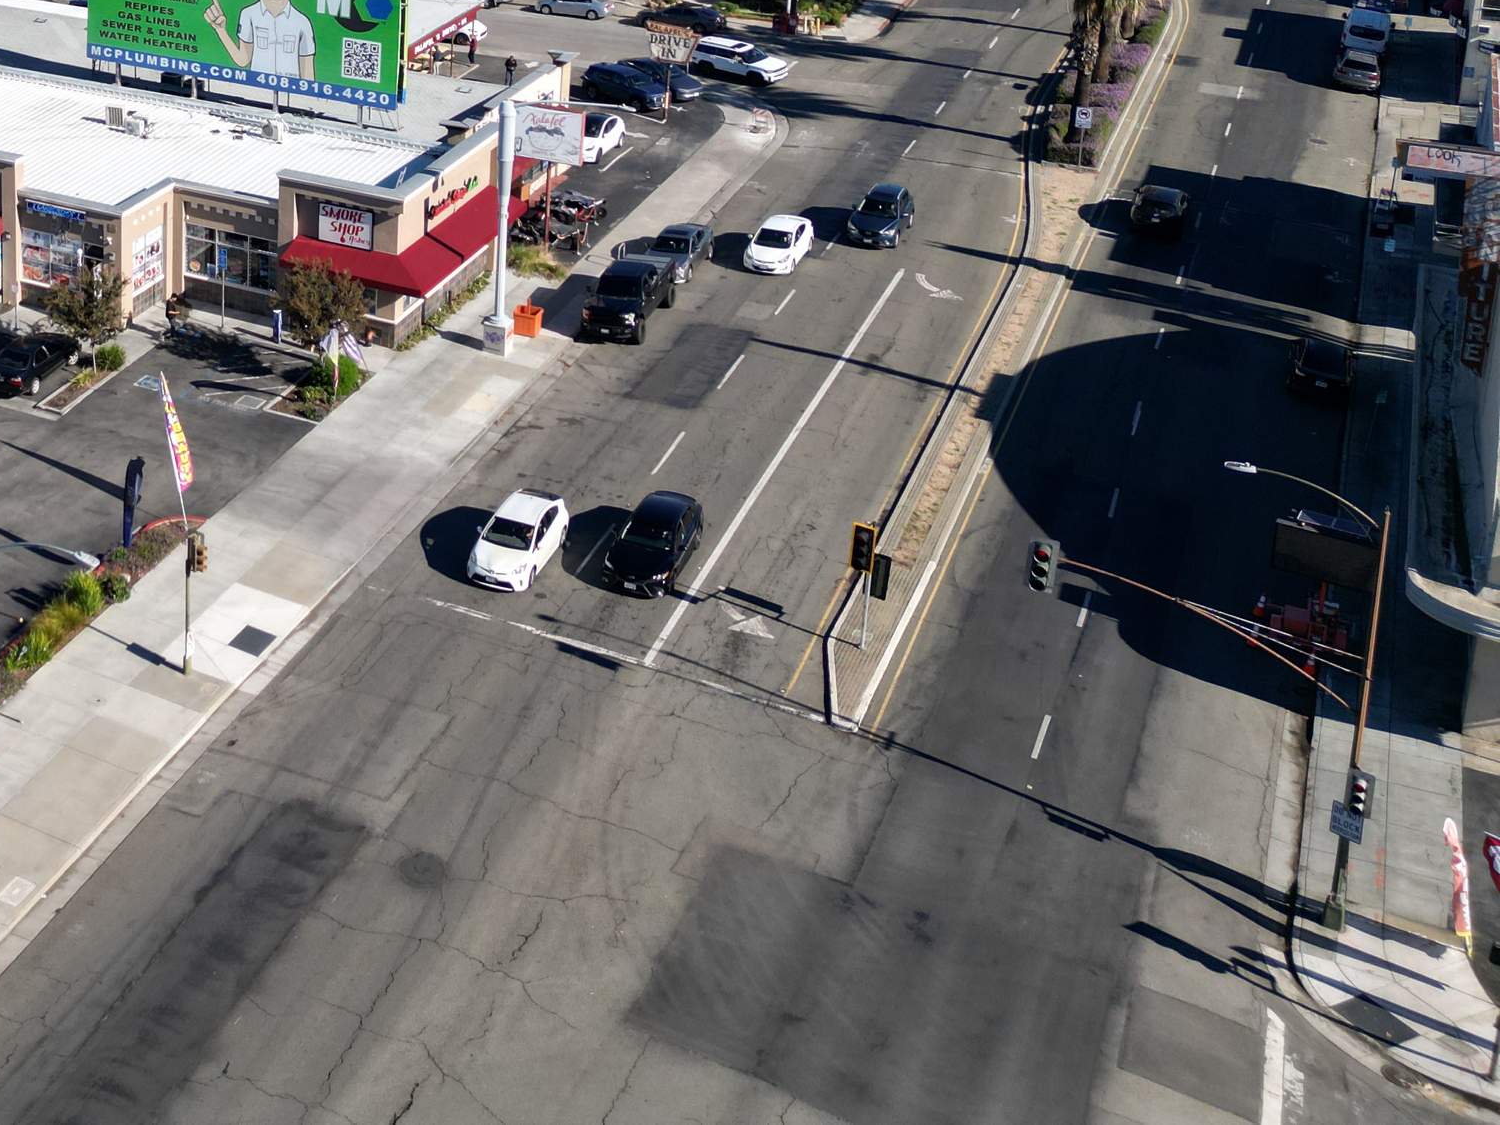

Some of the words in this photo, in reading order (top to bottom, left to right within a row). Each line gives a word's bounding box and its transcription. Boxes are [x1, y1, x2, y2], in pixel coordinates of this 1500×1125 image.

[124, 0, 175, 16] REPIPES
[117, 10, 143, 23] GAS
[145, 16, 181, 29] LINES
[102, 19, 142, 33] SEWER
[146, 26, 155, 35] &
[158, 29, 197, 42] DRAIN
[99, 29, 140, 44] WATER
[143, 37, 199, 54] HEATERS
[650, 34, 691, 49] DRIVE
[661, 46, 677, 59] IN
[90, 45, 247, 81] MCPLUMBING.COM
[256, 74, 390, 106] 408.916.4420
[322, 205, 366, 224] SMOKE
[329, 221, 365, 237] SHOP
